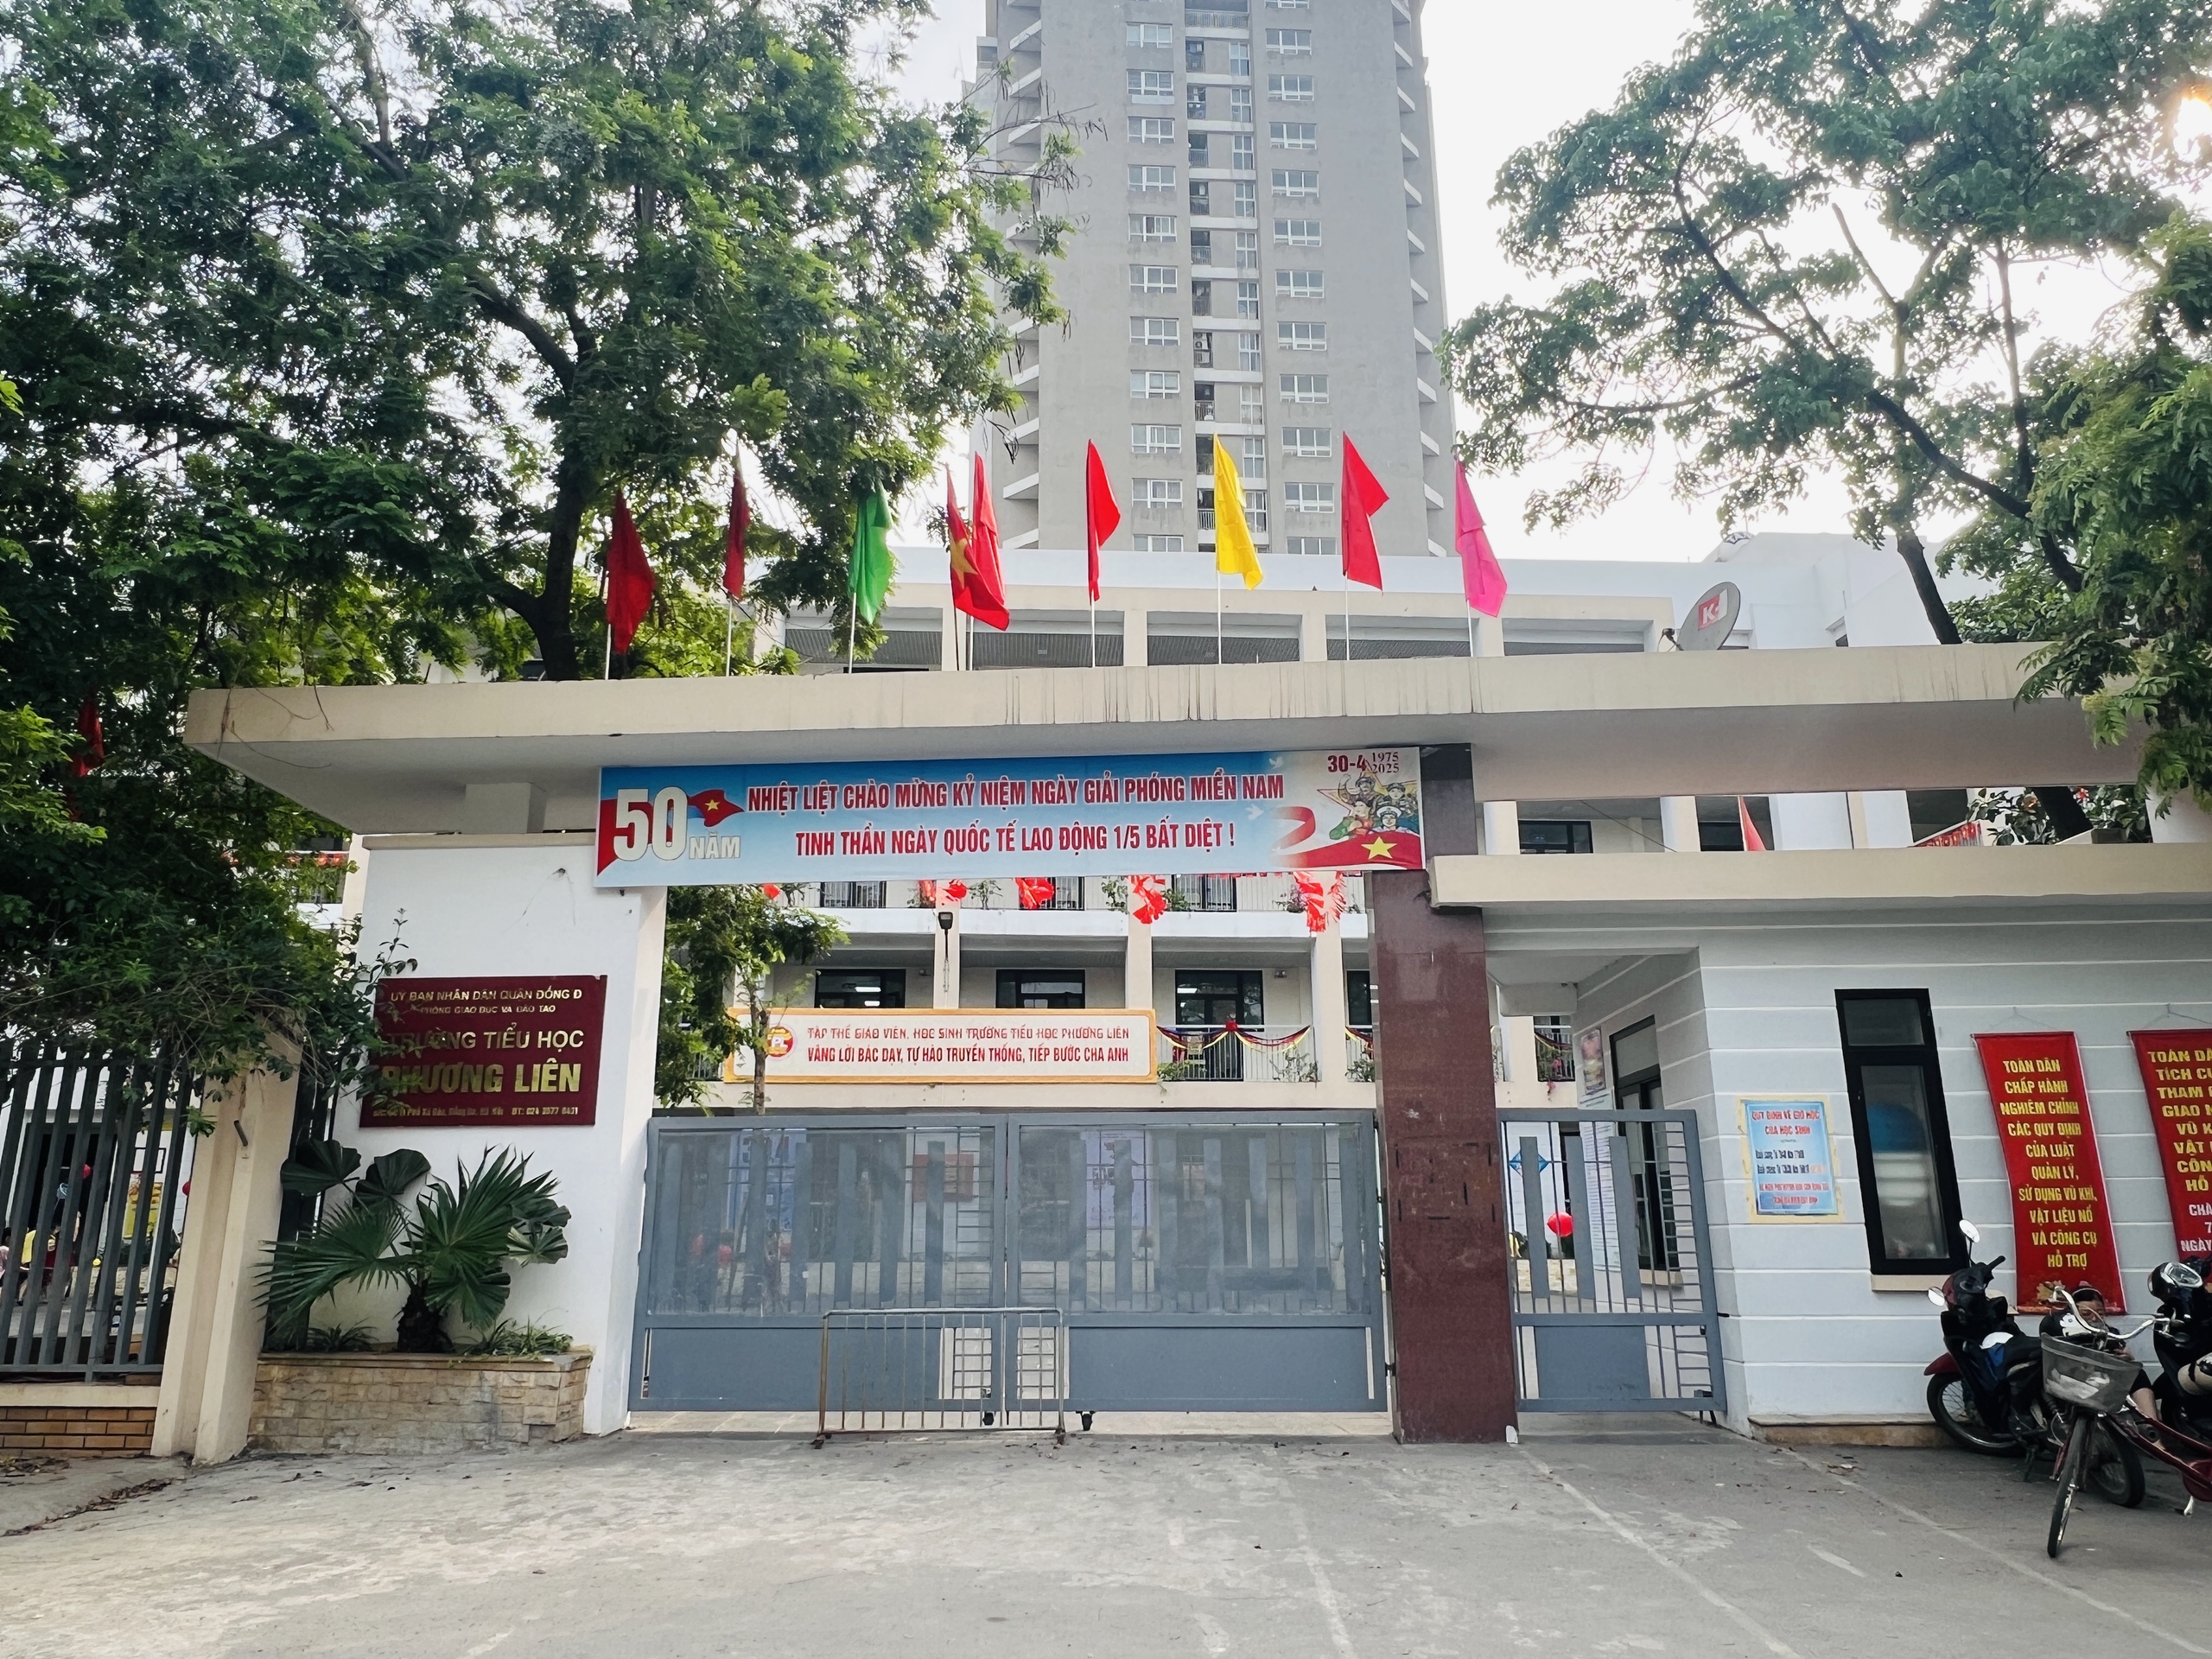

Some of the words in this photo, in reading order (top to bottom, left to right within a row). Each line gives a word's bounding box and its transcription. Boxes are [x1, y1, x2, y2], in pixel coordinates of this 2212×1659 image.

[1327, 754, 1367, 772] 30-4
[1371, 751, 1399, 763] 1975
[1371, 762, 1400, 773] 2025
[748, 781, 798, 815] NHIỆT
[803, 779, 838, 815] LIỆT
[842, 779, 889, 810] CHÀO
[894, 778, 947, 809] MỪNG
[953, 773, 976, 807] KỶ
[981, 776, 1026, 811] NIỆM
[1032, 775, 1077, 804] NGÀY
[1084, 771, 1119, 803] GIẢI
[1125, 772, 1185, 803] PHÓNG
[1242, 774, 1284, 800] NAM
[613, 785, 689, 861] 50
[796, 831, 835, 855] TINH
[841, 822, 886, 855] THẦN
[891, 825, 938, 854] NGÀY
[944, 819, 989, 855] QUỐC
[995, 818, 1016, 852] TẾ
[1021, 827, 1053, 851] LAO
[1058, 824, 1107, 855] ĐỘNG
[1114, 825, 1140, 850] 1/5
[1146, 816, 1180, 849] BẤT
[1185, 818, 1223, 853] DIỆT
[689, 830, 741, 860] NĂM
[410, 991, 434, 1001] BAN
[437, 988, 469, 1001] NHÂN
[473, 988, 497, 1001] DÂN
[536, 985, 570, 1000] ĐỐNG
[484, 1022, 530, 1049] TIỂU
[537, 1030, 584, 1052] HỌC
[855, 1026, 880, 1039] GIÁO
[913, 1027, 935, 1041] HỌC
[938, 1027, 963, 1039] SINH
[966, 1026, 1007, 1040] TRƯỜNG
[1036, 1027, 1058, 1040] HỌC
[1062, 1026, 1103, 1039] PHƯƠNG
[1107, 1026, 1129, 1039] LIÊN
[808, 1044, 836, 1062] VÂNG
[839, 1044, 855, 1062] LỜI
[858, 1044, 879, 1062] BÁC
[907, 1046, 920, 1065] TỰ
[923, 1044, 944, 1062] HÀO
[988, 1042, 1026, 1064] THỐNG,
[1028, 1043, 1050, 1062] TIẾP
[1053, 1044, 1081, 1062] BƯỚC
[1084, 1047, 1104, 1062] CHA
[1108, 1047, 1128, 1062] ANH
[2003, 1058, 2035, 1073] TOÀN
[2036, 1058, 2061, 1072] DÂN
[381, 1062, 504, 1094] PHƯƠNG
[514, 1057, 582, 1093] LIÊN
[2005, 1077, 2035, 1094] CHẤP
[2037, 1077, 2068, 1093] HÀNH
[2157, 1086, 2203, 1099] THAM
[2000, 1099, 2046, 1115] NGHIÊM
[2162, 1104, 2200, 1117] GIAO
[2007, 1120, 2031, 1135] CÁC
[2034, 1122, 2054, 1136] QUY
[2057, 1122, 2082, 1139] ĐỊNH
[2025, 1140, 2048, 1158] CỦA
[2050, 1141, 2075, 1160] LUẬT
[2018, 1184, 2032, 1201] SỬ
[2034, 1187, 2063, 1205] DỤNG
[2030, 1207, 2049, 1226] VẬT
[2052, 1207, 2075, 1226] LIỆU
[2031, 1230, 2047, 1245] VÀ
[2050, 1230, 2081, 1245] CÔNG
[2082, 1231, 2097, 1247] CỤ
[2066, 1253, 2088, 1270] TRỢ
